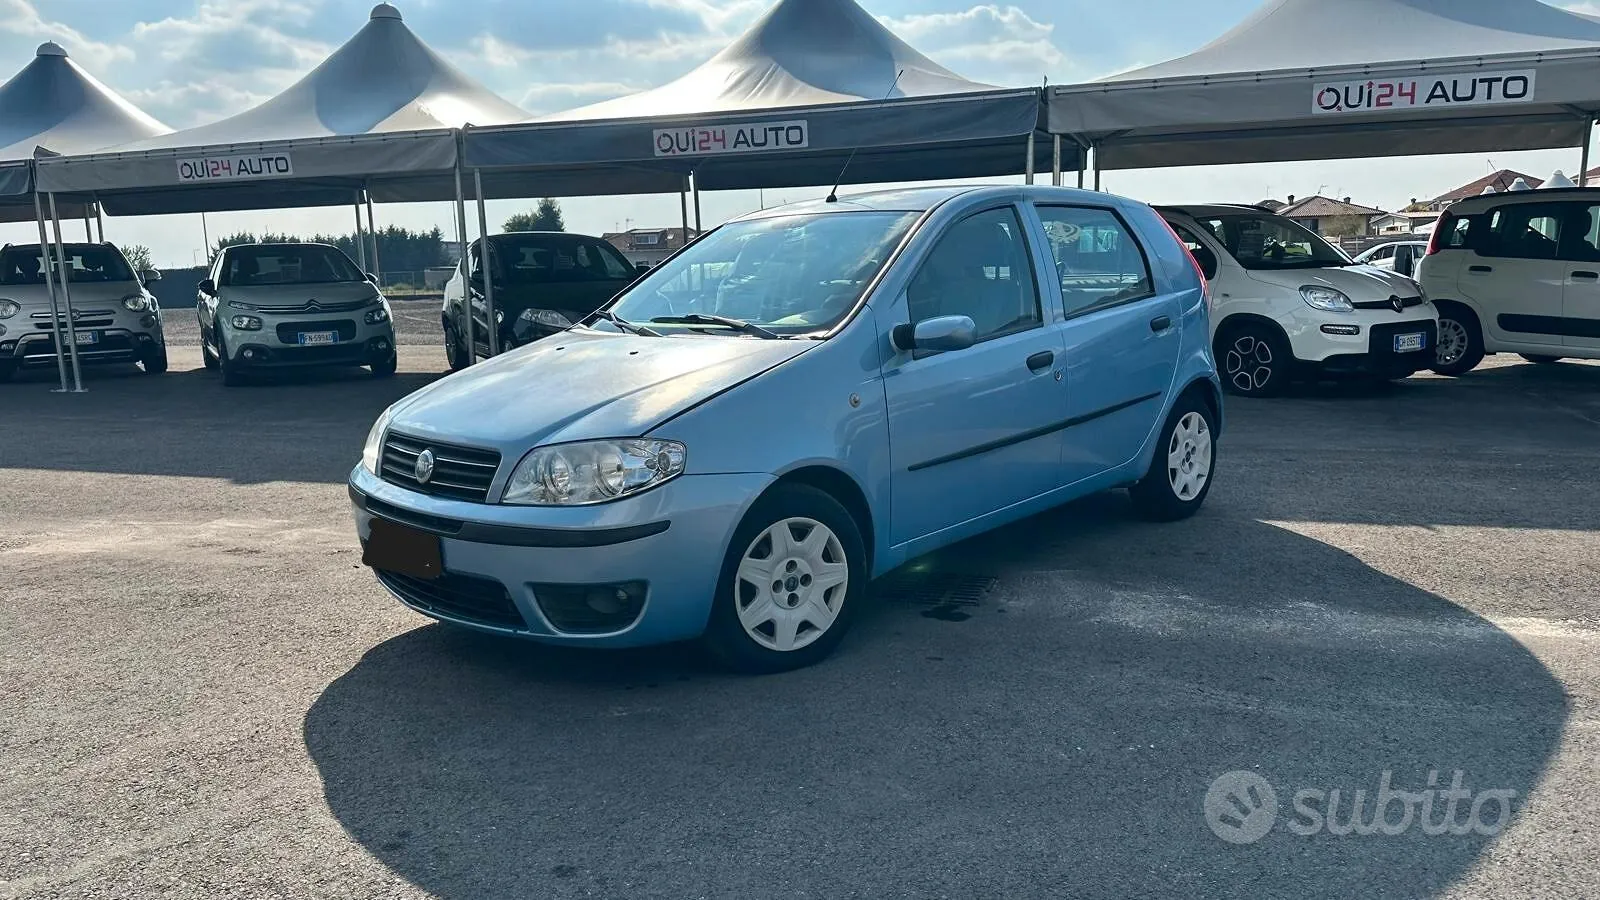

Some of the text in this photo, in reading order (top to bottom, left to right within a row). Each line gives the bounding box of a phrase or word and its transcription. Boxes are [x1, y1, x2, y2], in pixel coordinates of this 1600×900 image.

[1424, 76, 1528, 104] AUTO
[733, 126, 803, 149] AUTO
[237, 157, 289, 176] AUTO
